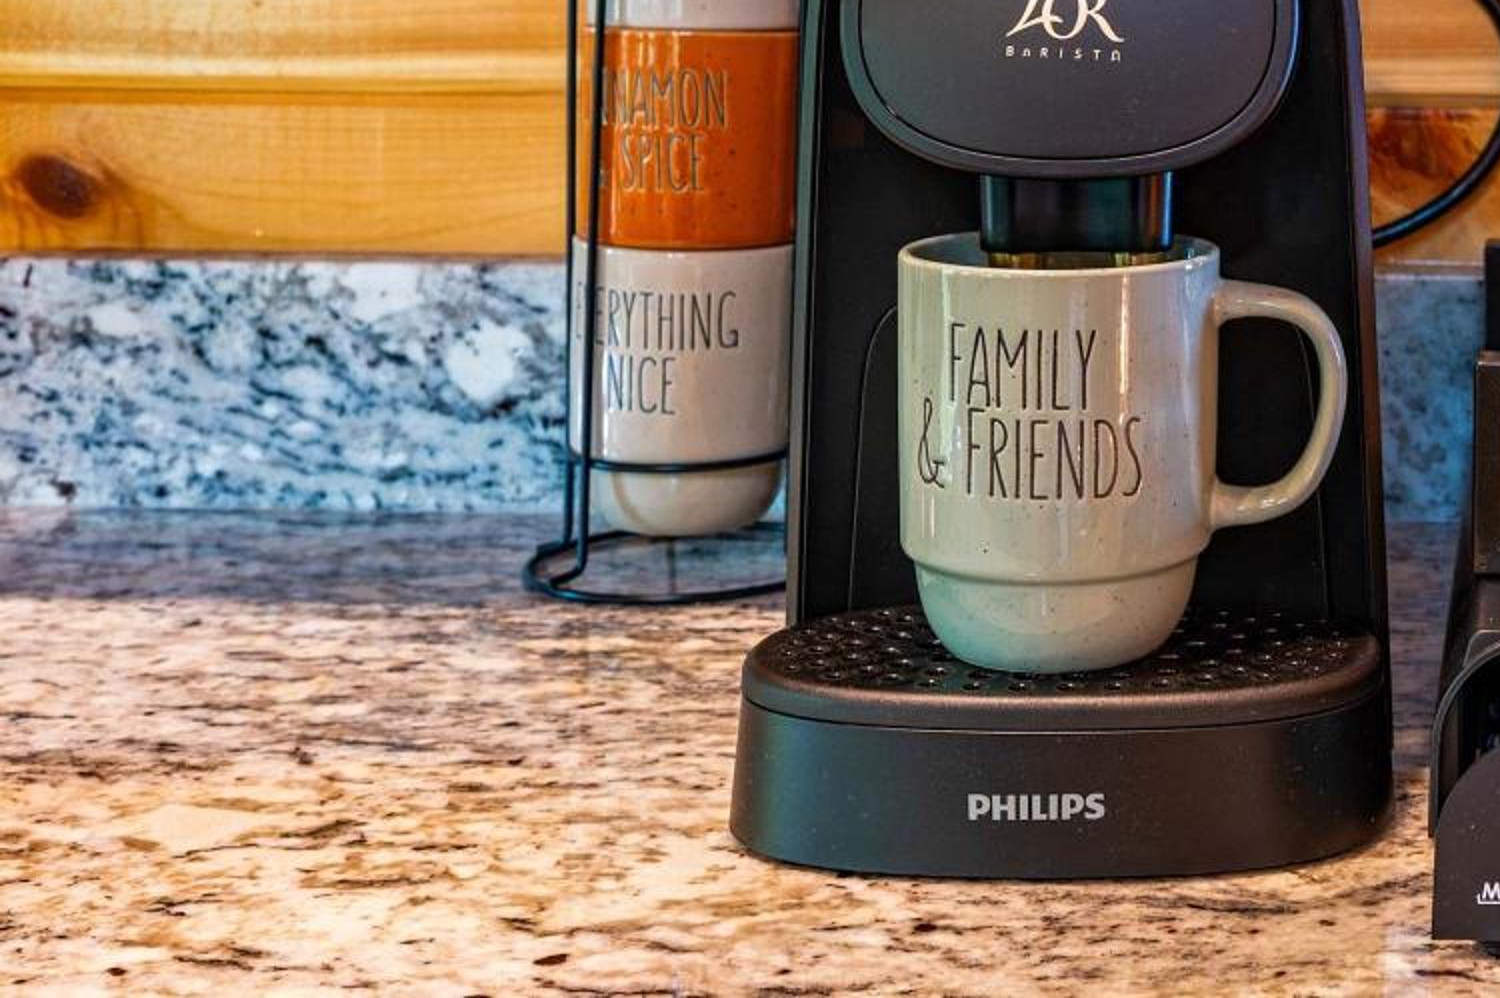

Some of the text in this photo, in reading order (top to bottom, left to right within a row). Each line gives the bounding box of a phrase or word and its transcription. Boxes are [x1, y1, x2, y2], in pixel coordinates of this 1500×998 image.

[1004, 45, 1121, 62] BARISTA
[623, 131, 704, 192] SPICE
[576, 281, 739, 350] EERYTHING
[607, 354, 676, 415] NICE
[948, 322, 1097, 411] FAMILY
[917, 397, 1144, 500] & FRIENDS
[967, 793, 1106, 821] PHILIPS
